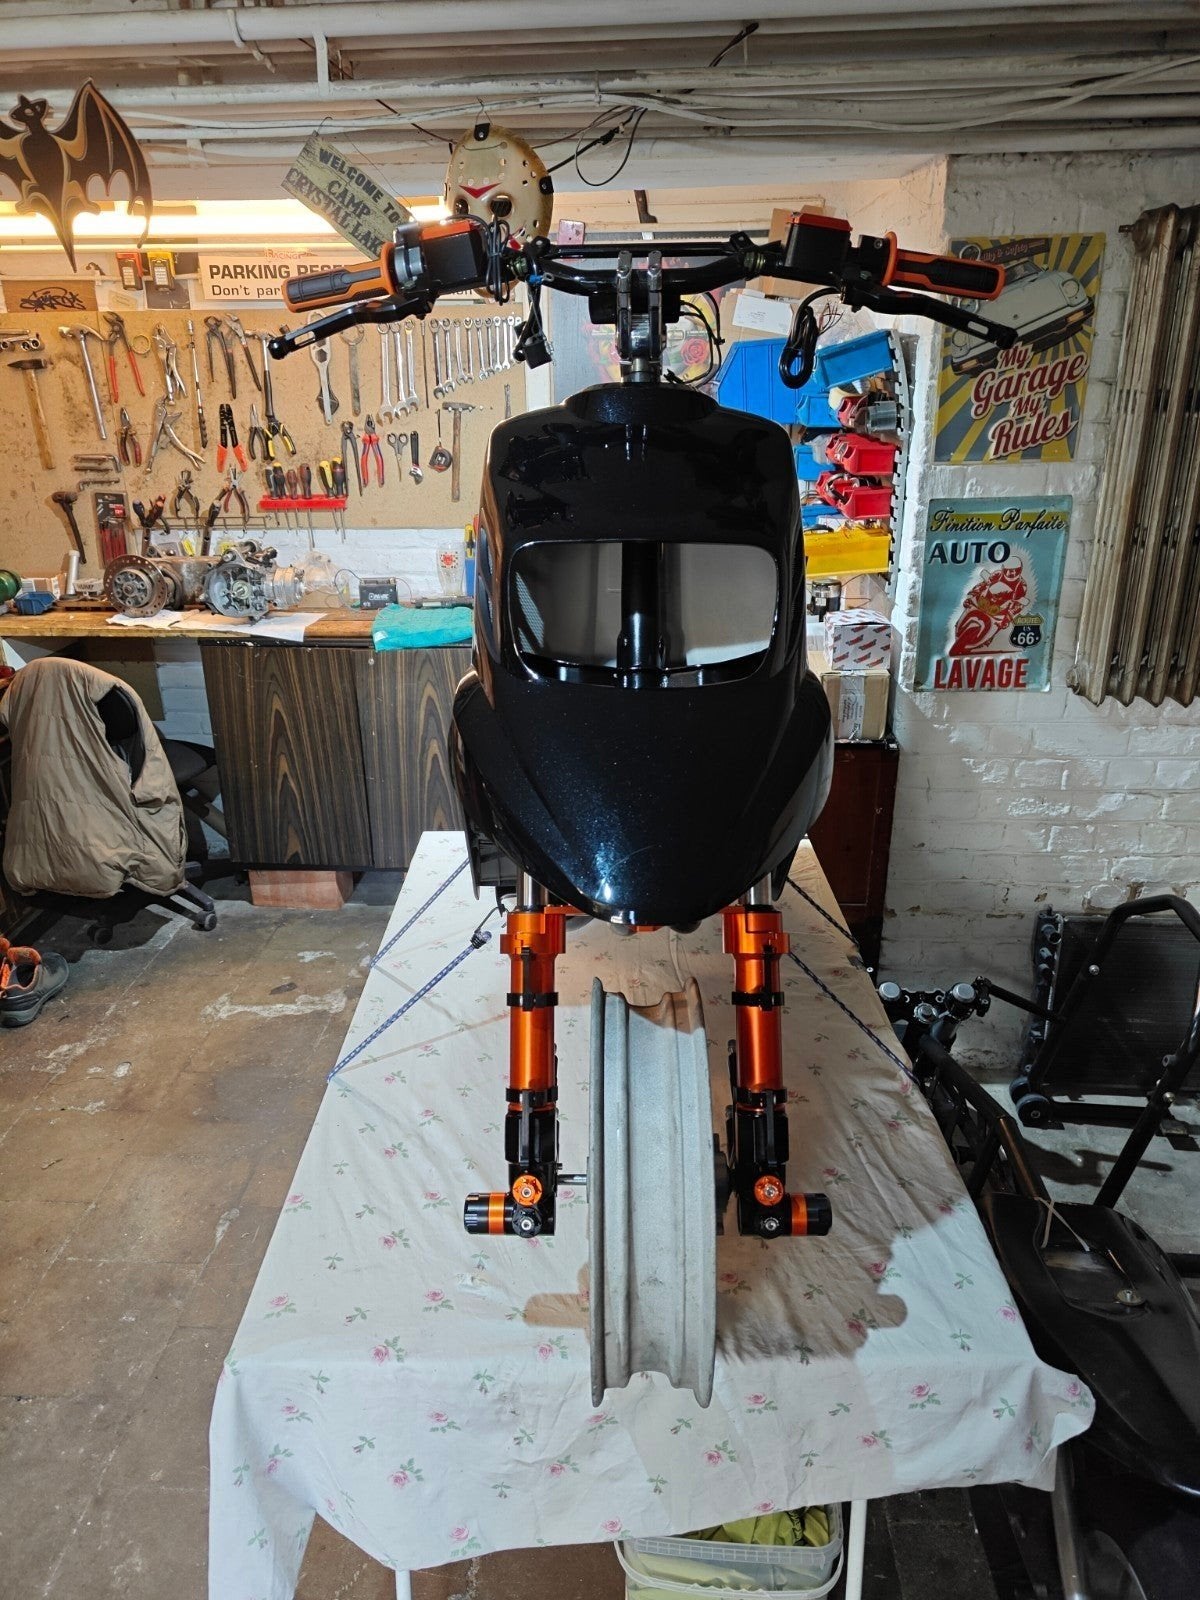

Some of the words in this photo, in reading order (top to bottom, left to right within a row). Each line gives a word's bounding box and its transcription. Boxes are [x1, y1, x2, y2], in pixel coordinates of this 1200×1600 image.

[319, 148, 384, 204] WELCOME
[382, 202, 401, 224] TO
[327, 180, 371, 219] CAMP
[285, 167, 352, 230] CRYSTAL
[348, 220, 385, 258] LAK
[209, 264, 290, 280] PARKING
[211, 284, 251, 297] Don't
[256, 287, 282, 299] par
[1000, 344, 1030, 370] My
[973, 353, 1088, 418] Garage
[1012, 394, 1042, 418] My
[990, 411, 1071, 457] Rules
[930, 509, 996, 533] Finition
[999, 507, 1067, 539] Parfaite
[928, 541, 1011, 565] AUTO
[1017, 631, 1035, 645] 66
[934, 658, 1029, 689] LAVAGE
